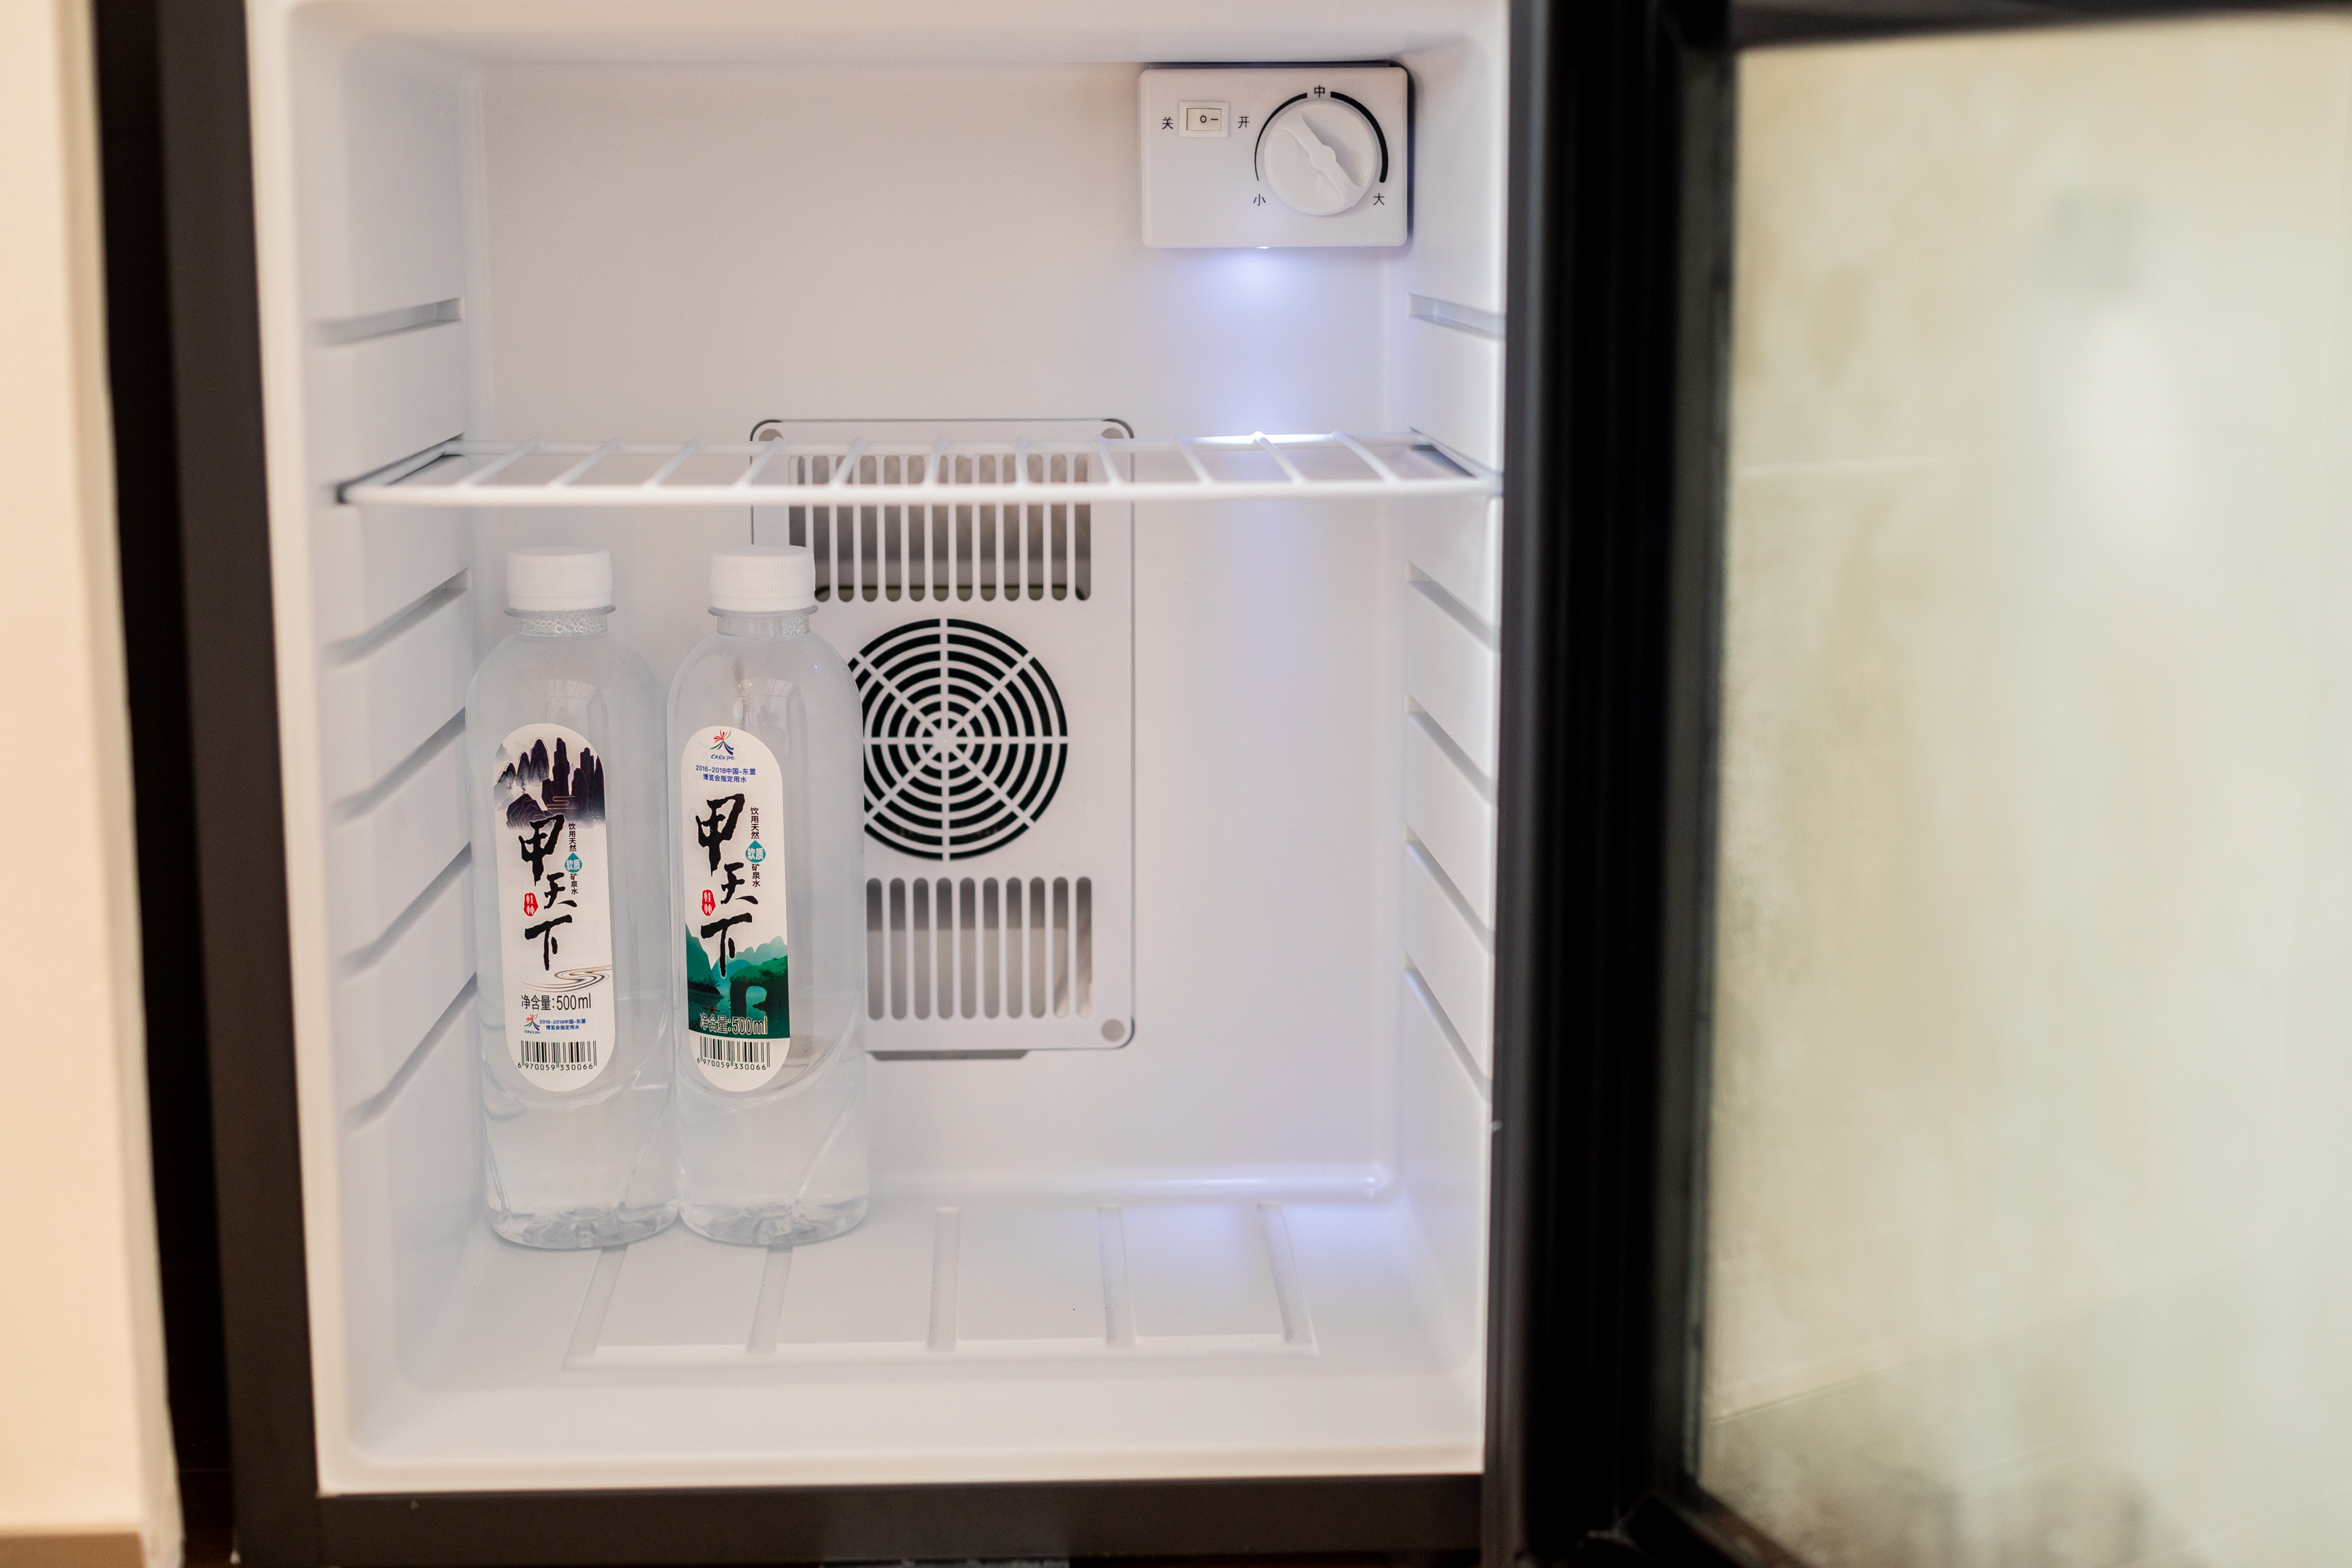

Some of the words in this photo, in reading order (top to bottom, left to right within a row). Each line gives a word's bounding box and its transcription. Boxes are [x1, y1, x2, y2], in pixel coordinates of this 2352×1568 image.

[1314, 85, 1325, 98] 中
[1162, 117, 1174, 130] 关
[1237, 116, 1250, 128] 开
[1253, 194, 1266, 206] 小
[1372, 192, 1385, 205] 大
[703, 773, 747, 783] 博览会指定用水
[750, 806, 759, 839] 饮用天然
[568, 822, 577, 852] 饮用天然
[747, 847, 764, 861] 软质
[566, 858, 581, 871] 软质
[751, 863, 761, 888] 矿泉水
[570, 873, 579, 895] 矿泉水
[695, 793, 759, 978] 甲天下
[518, 814, 578, 971] 甲天下
